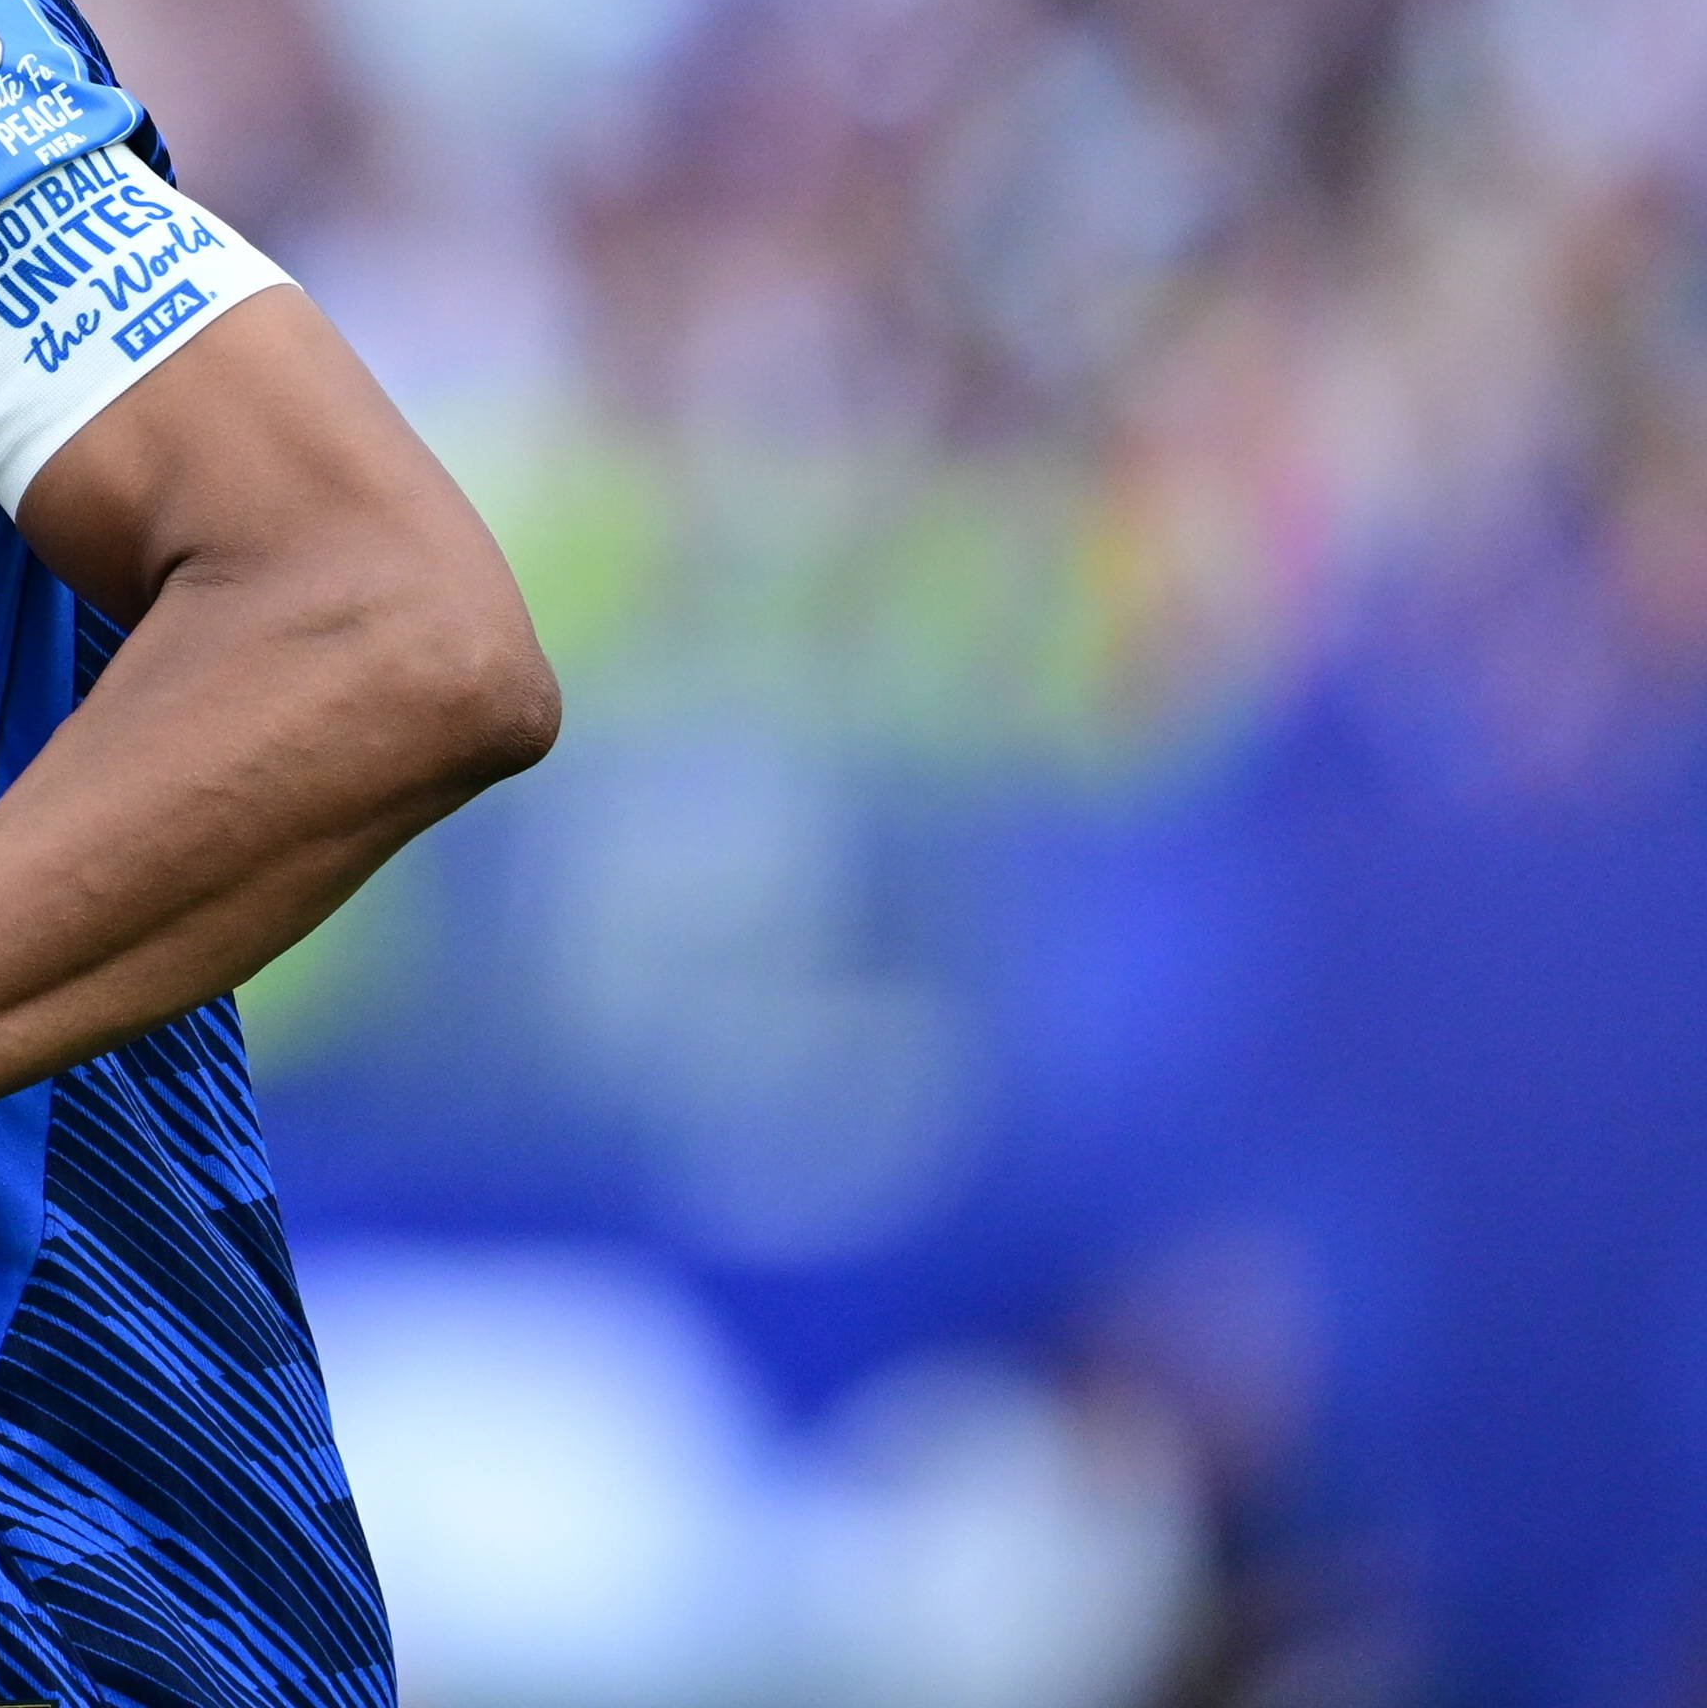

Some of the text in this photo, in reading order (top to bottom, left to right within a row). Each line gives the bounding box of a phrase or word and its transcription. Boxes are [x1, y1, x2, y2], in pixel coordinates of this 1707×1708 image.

[16, 53, 56, 92] Fo
[34, 131, 84, 166] FIFA
[23, 216, 226, 373] the World
[123, 292, 200, 351] FIFA
